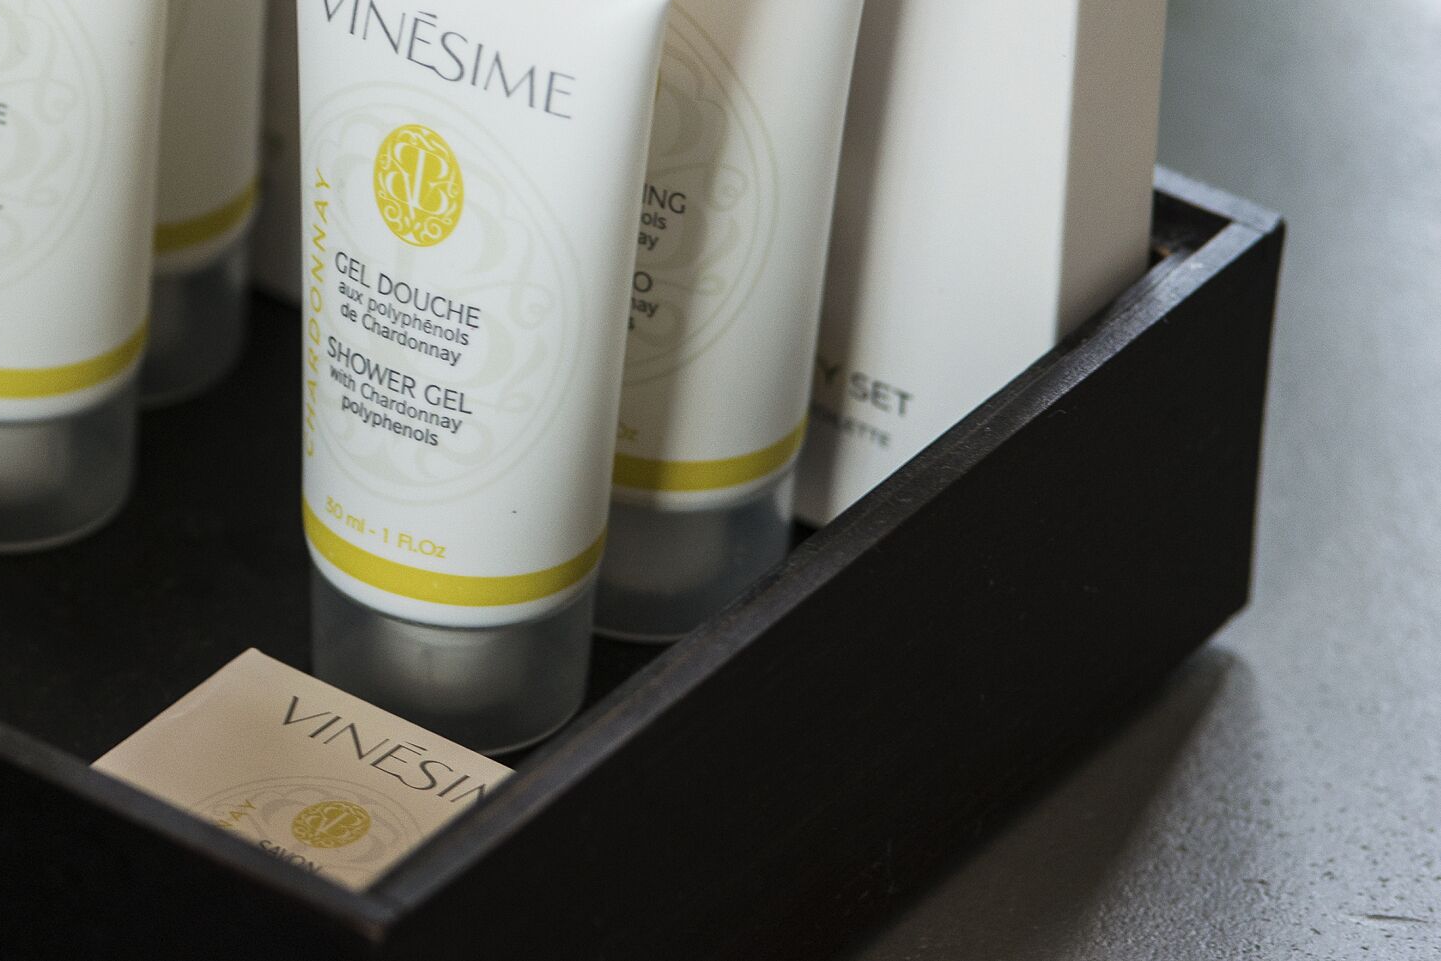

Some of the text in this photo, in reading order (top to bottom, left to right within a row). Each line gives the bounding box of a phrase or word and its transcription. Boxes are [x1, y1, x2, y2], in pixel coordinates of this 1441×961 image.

[335, 251, 481, 329] GEL DOUCHE
[338, 281, 469, 346] aux polyphénols
[340, 303, 462, 367] de Chardonnay
[327, 336, 473, 415] SHOWER GEL
[330, 365, 463, 434] with Chardonnay
[849, 371, 915, 417] SET
[341, 395, 439, 447] polyphenols
[326, 495, 344, 520] 30
